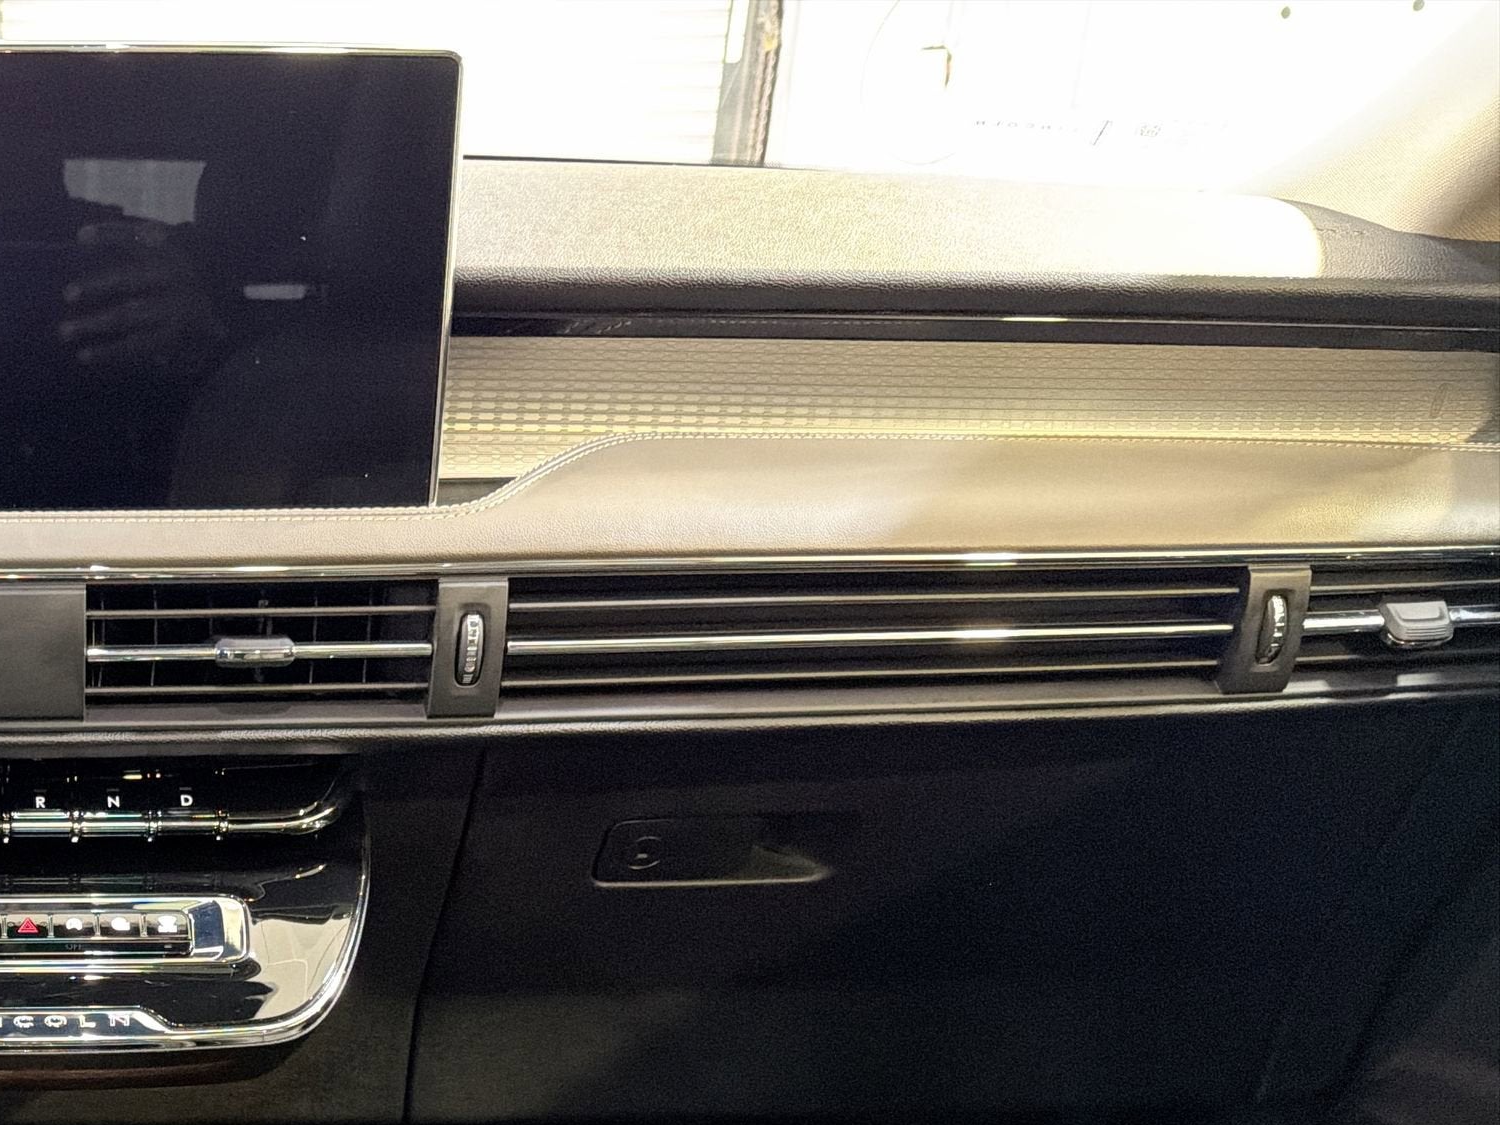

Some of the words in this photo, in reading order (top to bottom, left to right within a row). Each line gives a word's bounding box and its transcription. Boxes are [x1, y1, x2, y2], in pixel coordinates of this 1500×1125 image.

[35, 796, 46, 808] R
[107, 796, 120, 808] N
[180, 794, 193, 807] D
